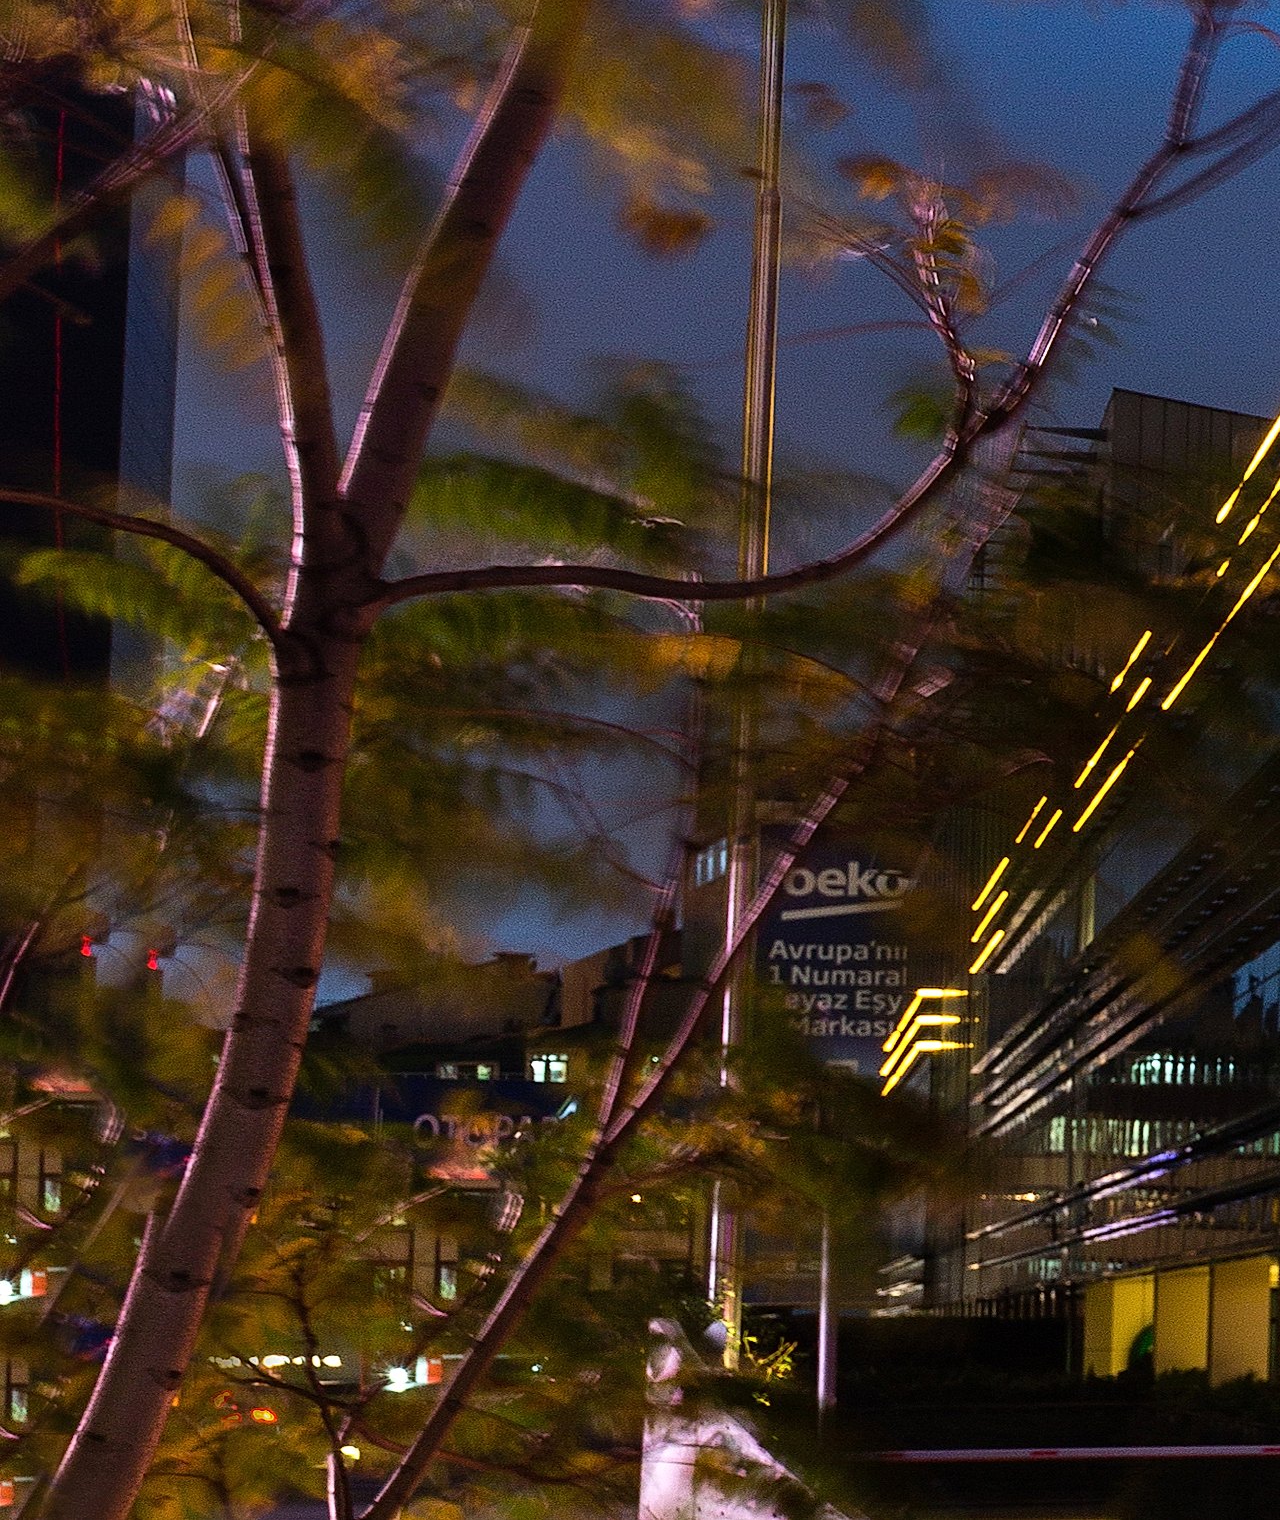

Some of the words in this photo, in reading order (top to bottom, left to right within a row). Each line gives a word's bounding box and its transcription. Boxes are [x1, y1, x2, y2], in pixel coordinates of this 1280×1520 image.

[791, 966, 907, 986] Numaral
[784, 993, 848, 1013] eyaz
[856, 989, 902, 1014] Eşy
